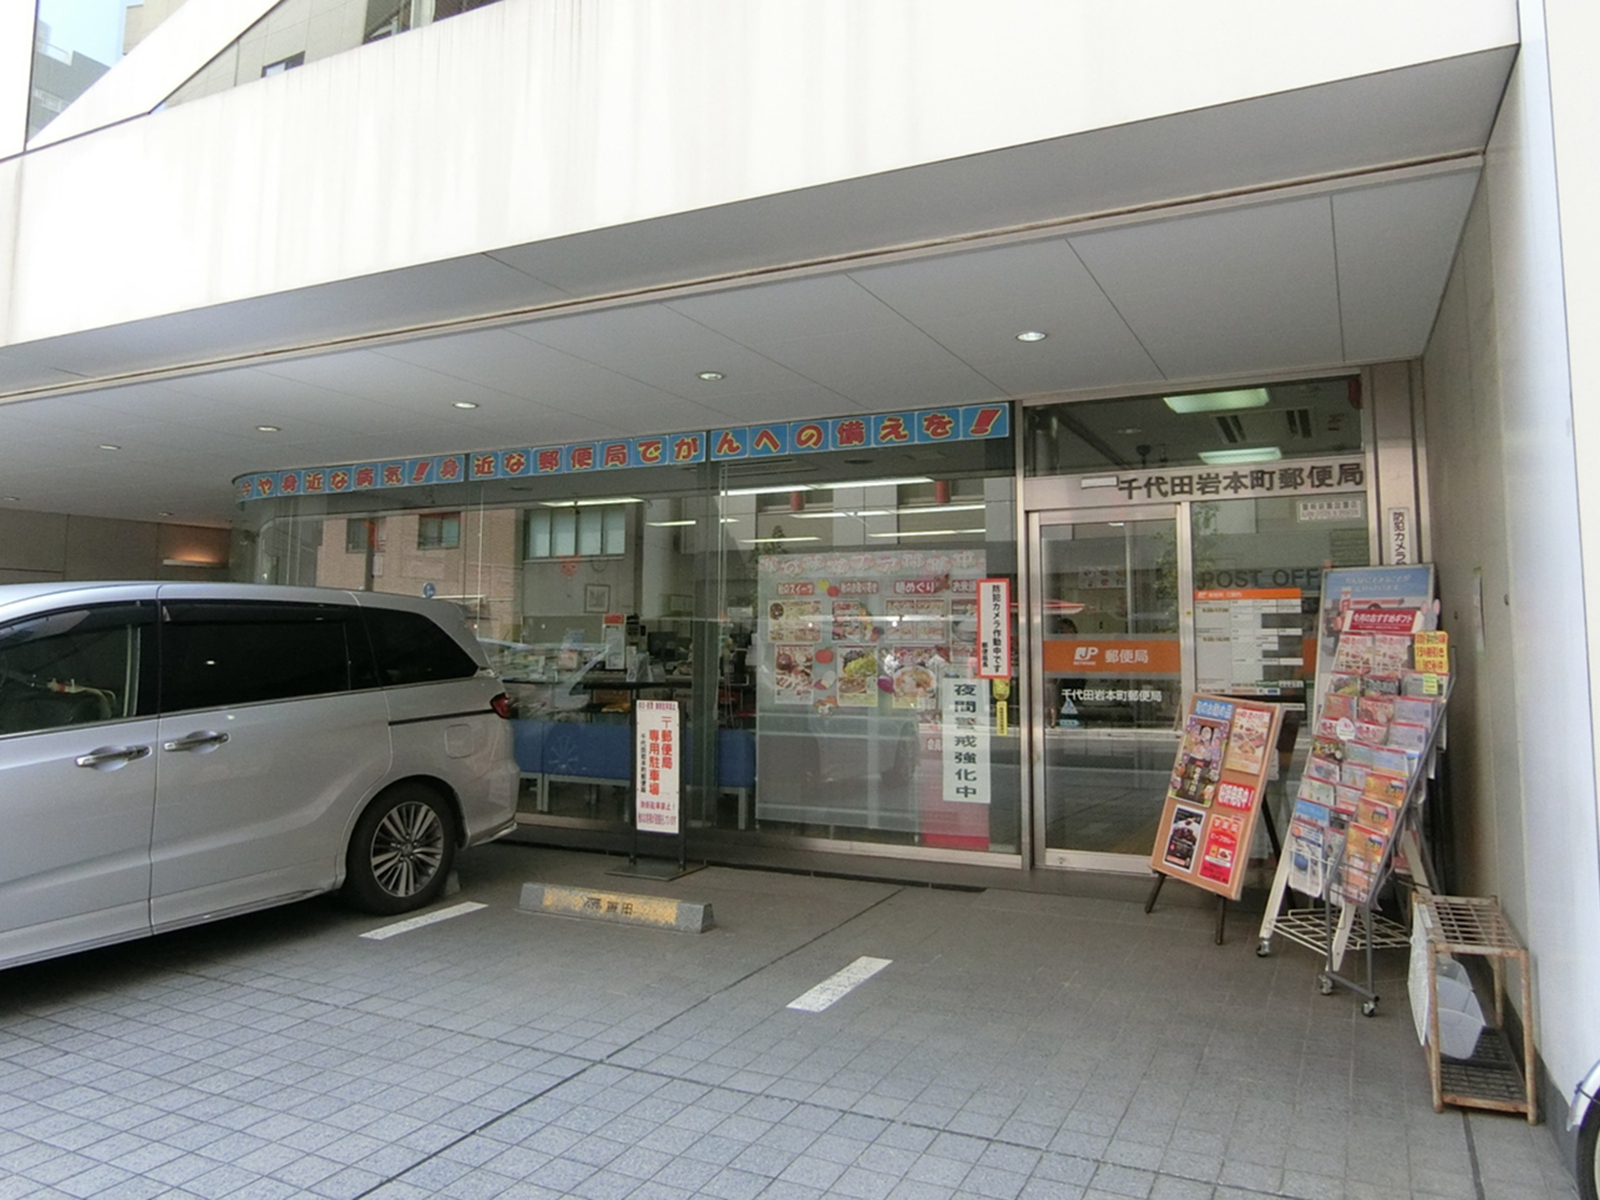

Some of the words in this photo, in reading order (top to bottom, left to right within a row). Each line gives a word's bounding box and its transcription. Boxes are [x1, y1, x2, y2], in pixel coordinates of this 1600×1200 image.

[1118, 464, 1365, 499] 千代田岩本町郵便局
[992, 585, 1002, 673] 防犯カメラ作動中です
[1105, 649, 1149, 664] 郵便局
[1061, 689, 1163, 702] 千代田岩本町郵便局
[649, 729, 660, 796] 専用駐車場
[954, 684, 977, 798] 夜間警戒強化中
